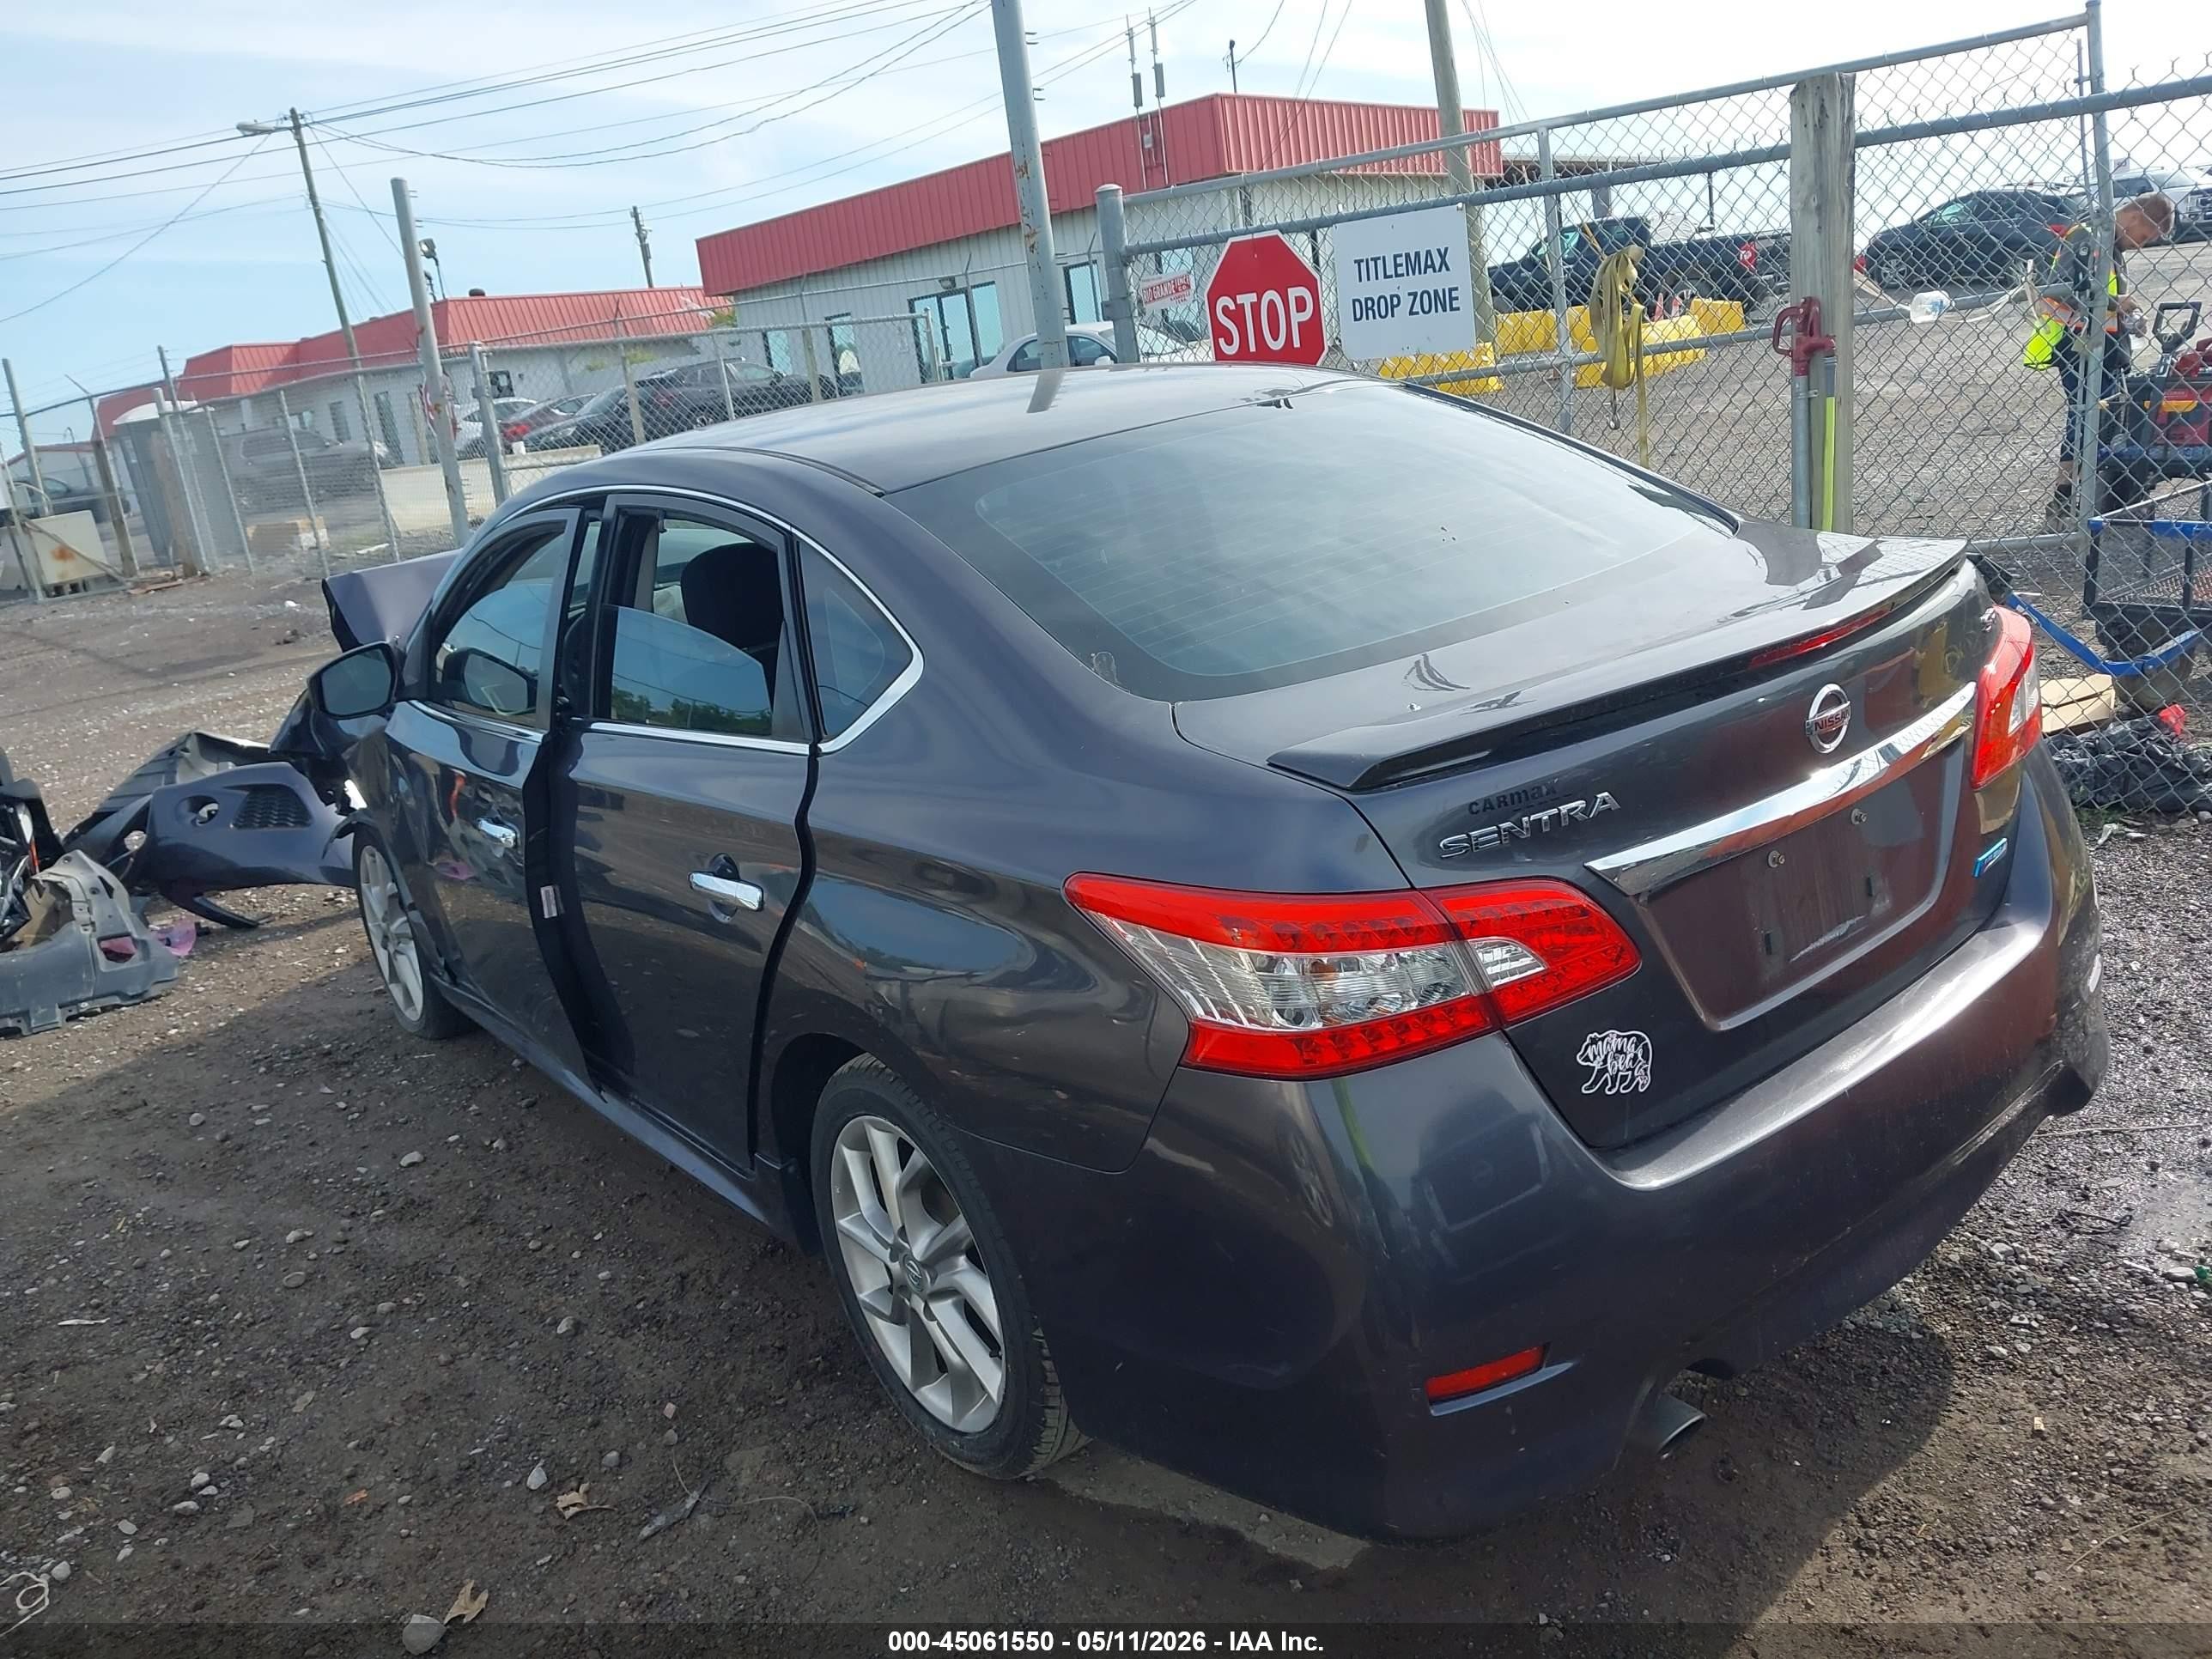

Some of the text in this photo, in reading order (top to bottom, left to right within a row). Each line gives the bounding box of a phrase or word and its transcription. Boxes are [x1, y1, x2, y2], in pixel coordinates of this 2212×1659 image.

[1353, 246, 1451, 283] TITLEMAX
[1152, 279, 1176, 300] GRANDE
[1352, 286, 1461, 322] DROP ZONE
[1215, 286, 1314, 356] STOP
[1814, 708, 1850, 732] NISSAN
[1439, 791, 1621, 859] SENTRA
